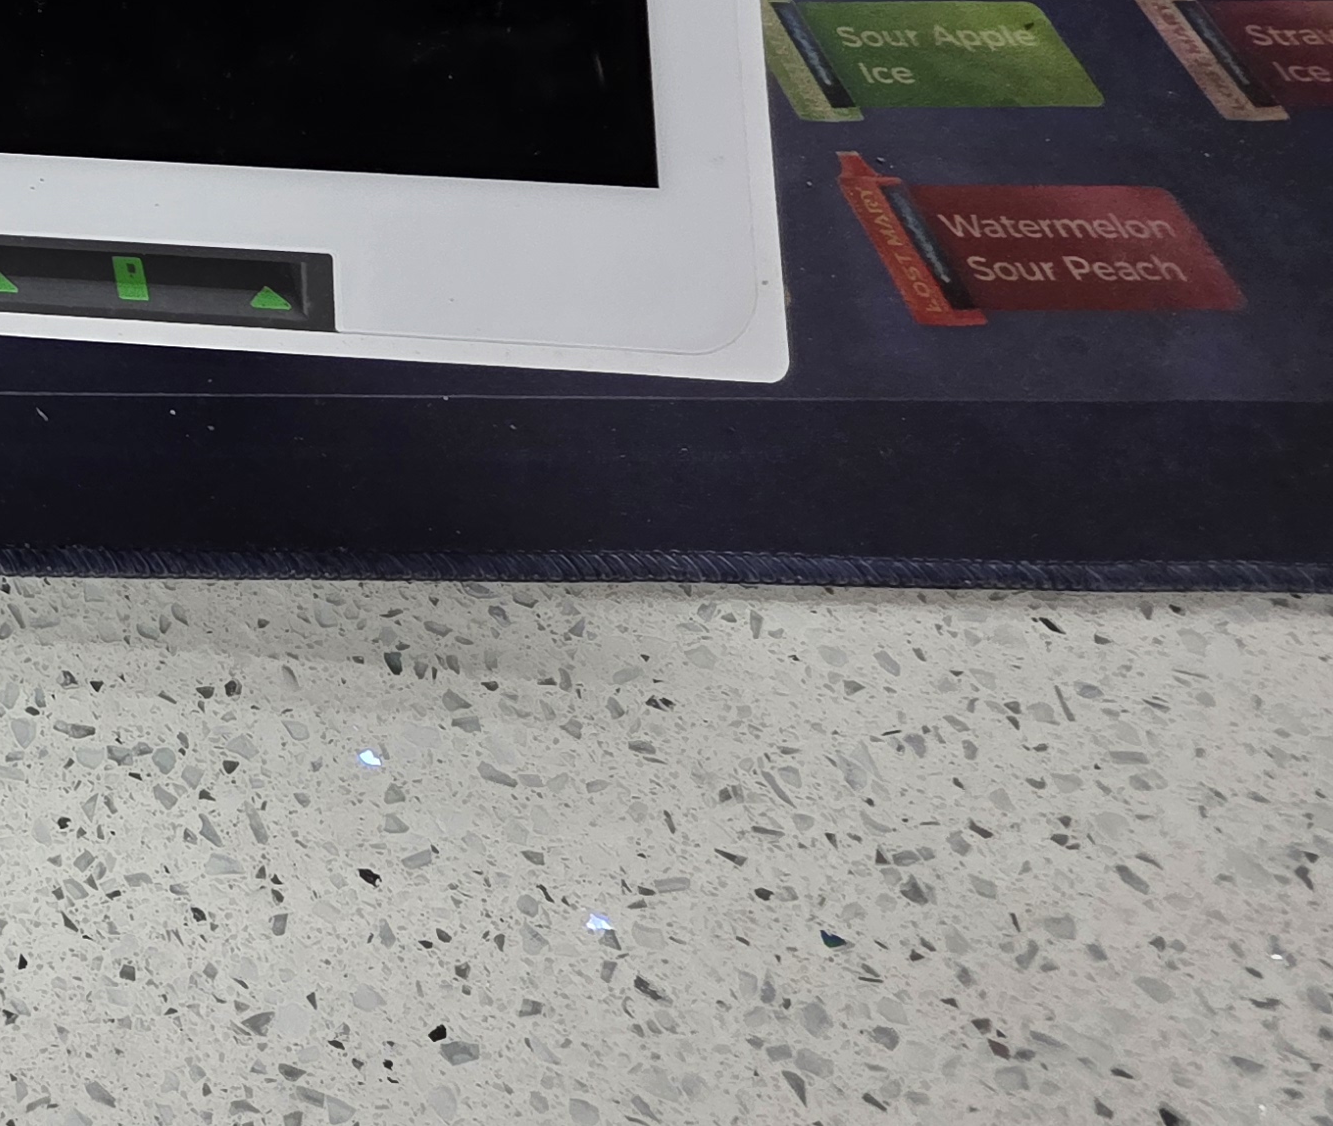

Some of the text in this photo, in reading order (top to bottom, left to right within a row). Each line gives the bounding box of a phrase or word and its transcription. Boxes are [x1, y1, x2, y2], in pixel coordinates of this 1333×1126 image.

[837, 24, 1037, 54] Sour Apple
[859, 63, 916, 85] Ice
[938, 212, 1175, 241] Watermelon
[967, 255, 1187, 283] Sour Peach
